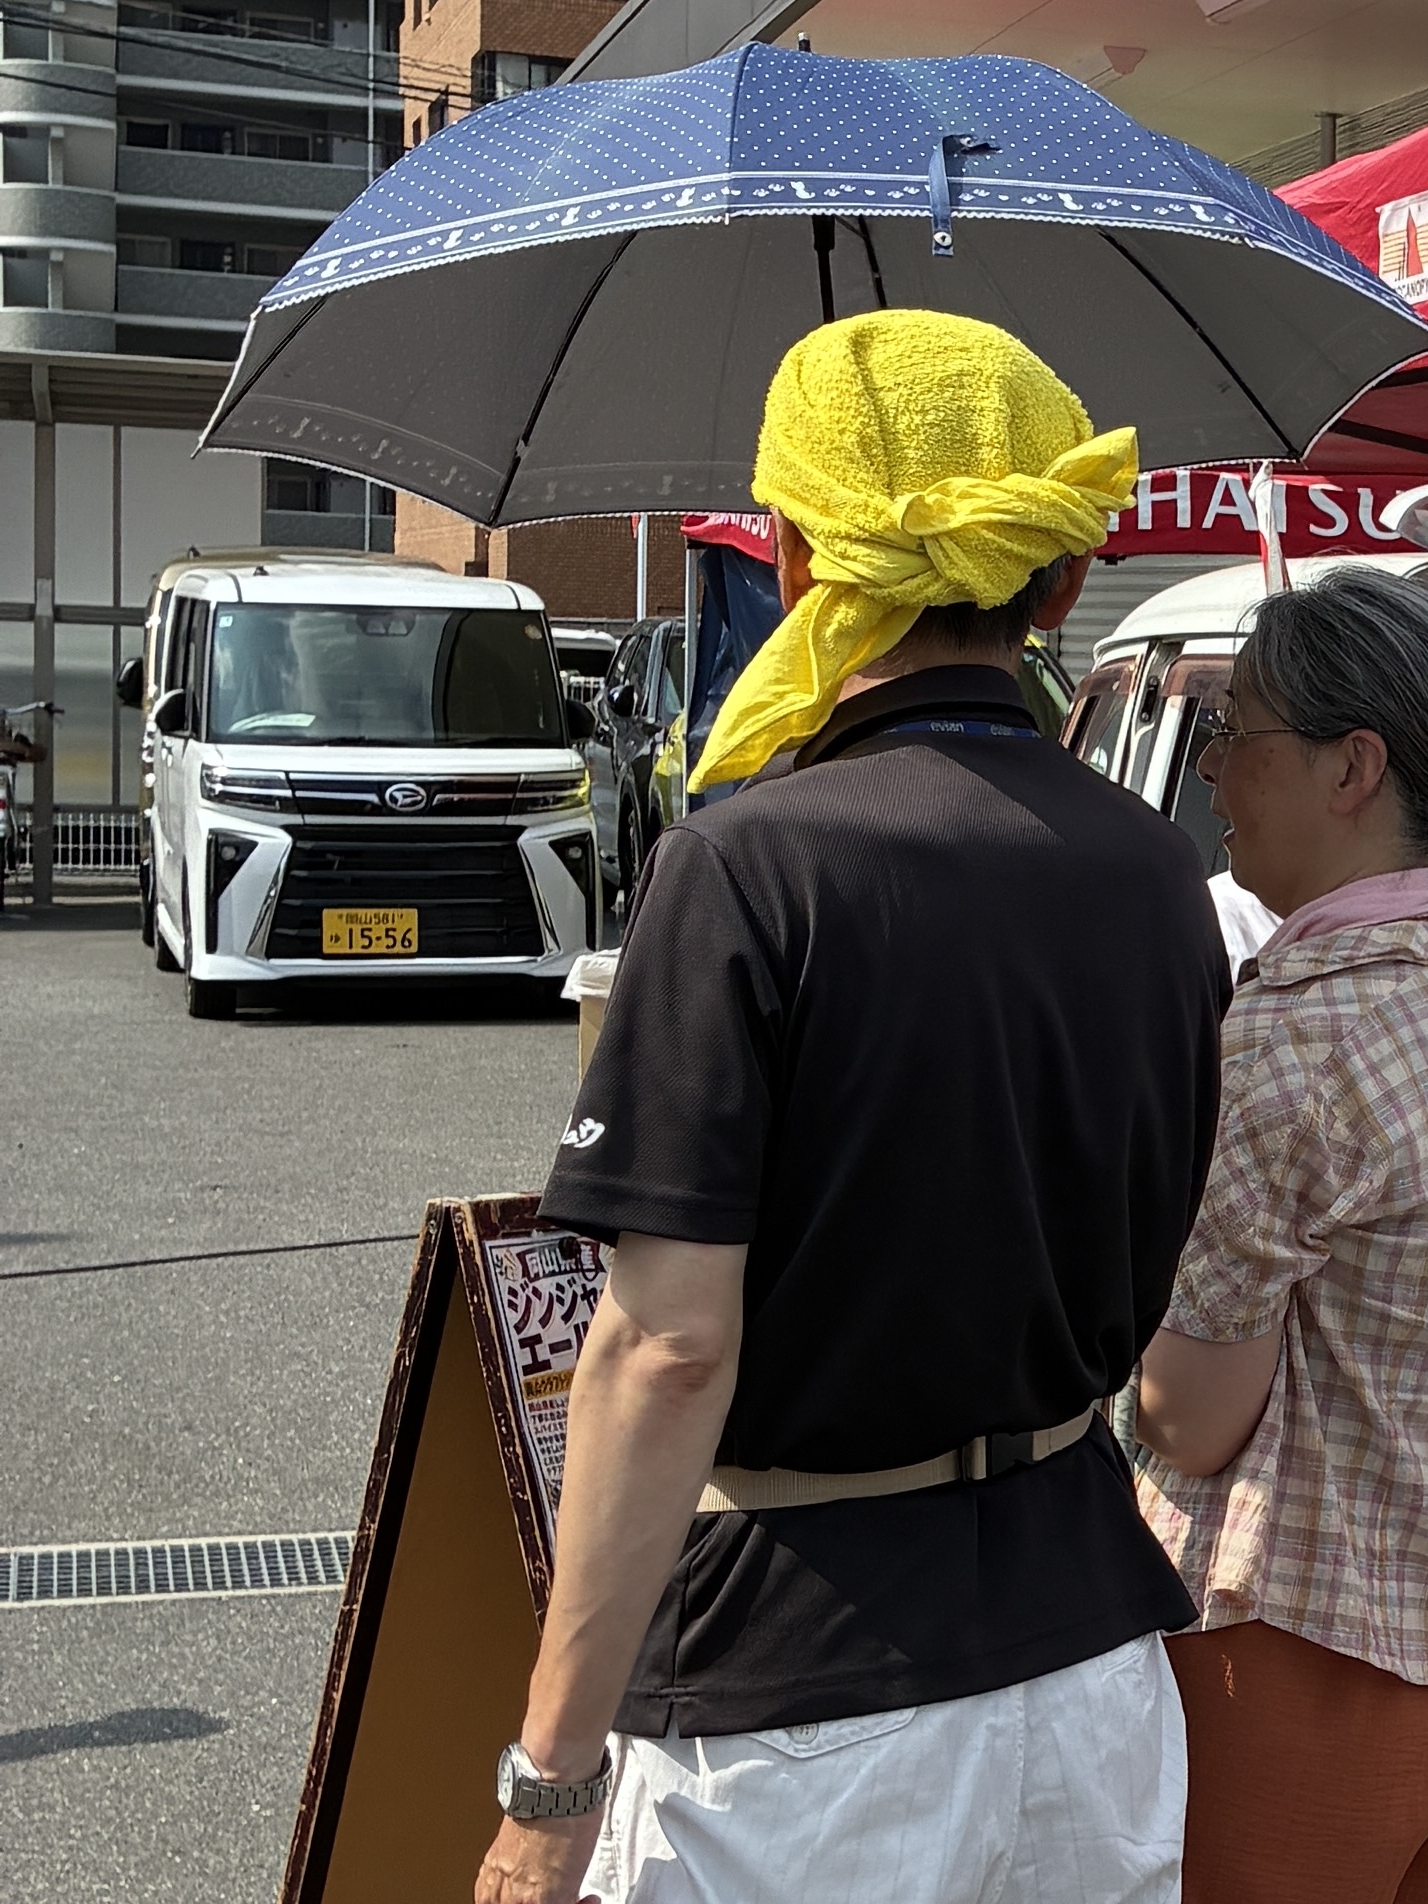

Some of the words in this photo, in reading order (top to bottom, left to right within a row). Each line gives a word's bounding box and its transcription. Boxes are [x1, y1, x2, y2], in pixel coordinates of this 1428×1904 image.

[348, 927, 413, 950] 15-56
[507, 1275, 604, 1336] ジンジャ
